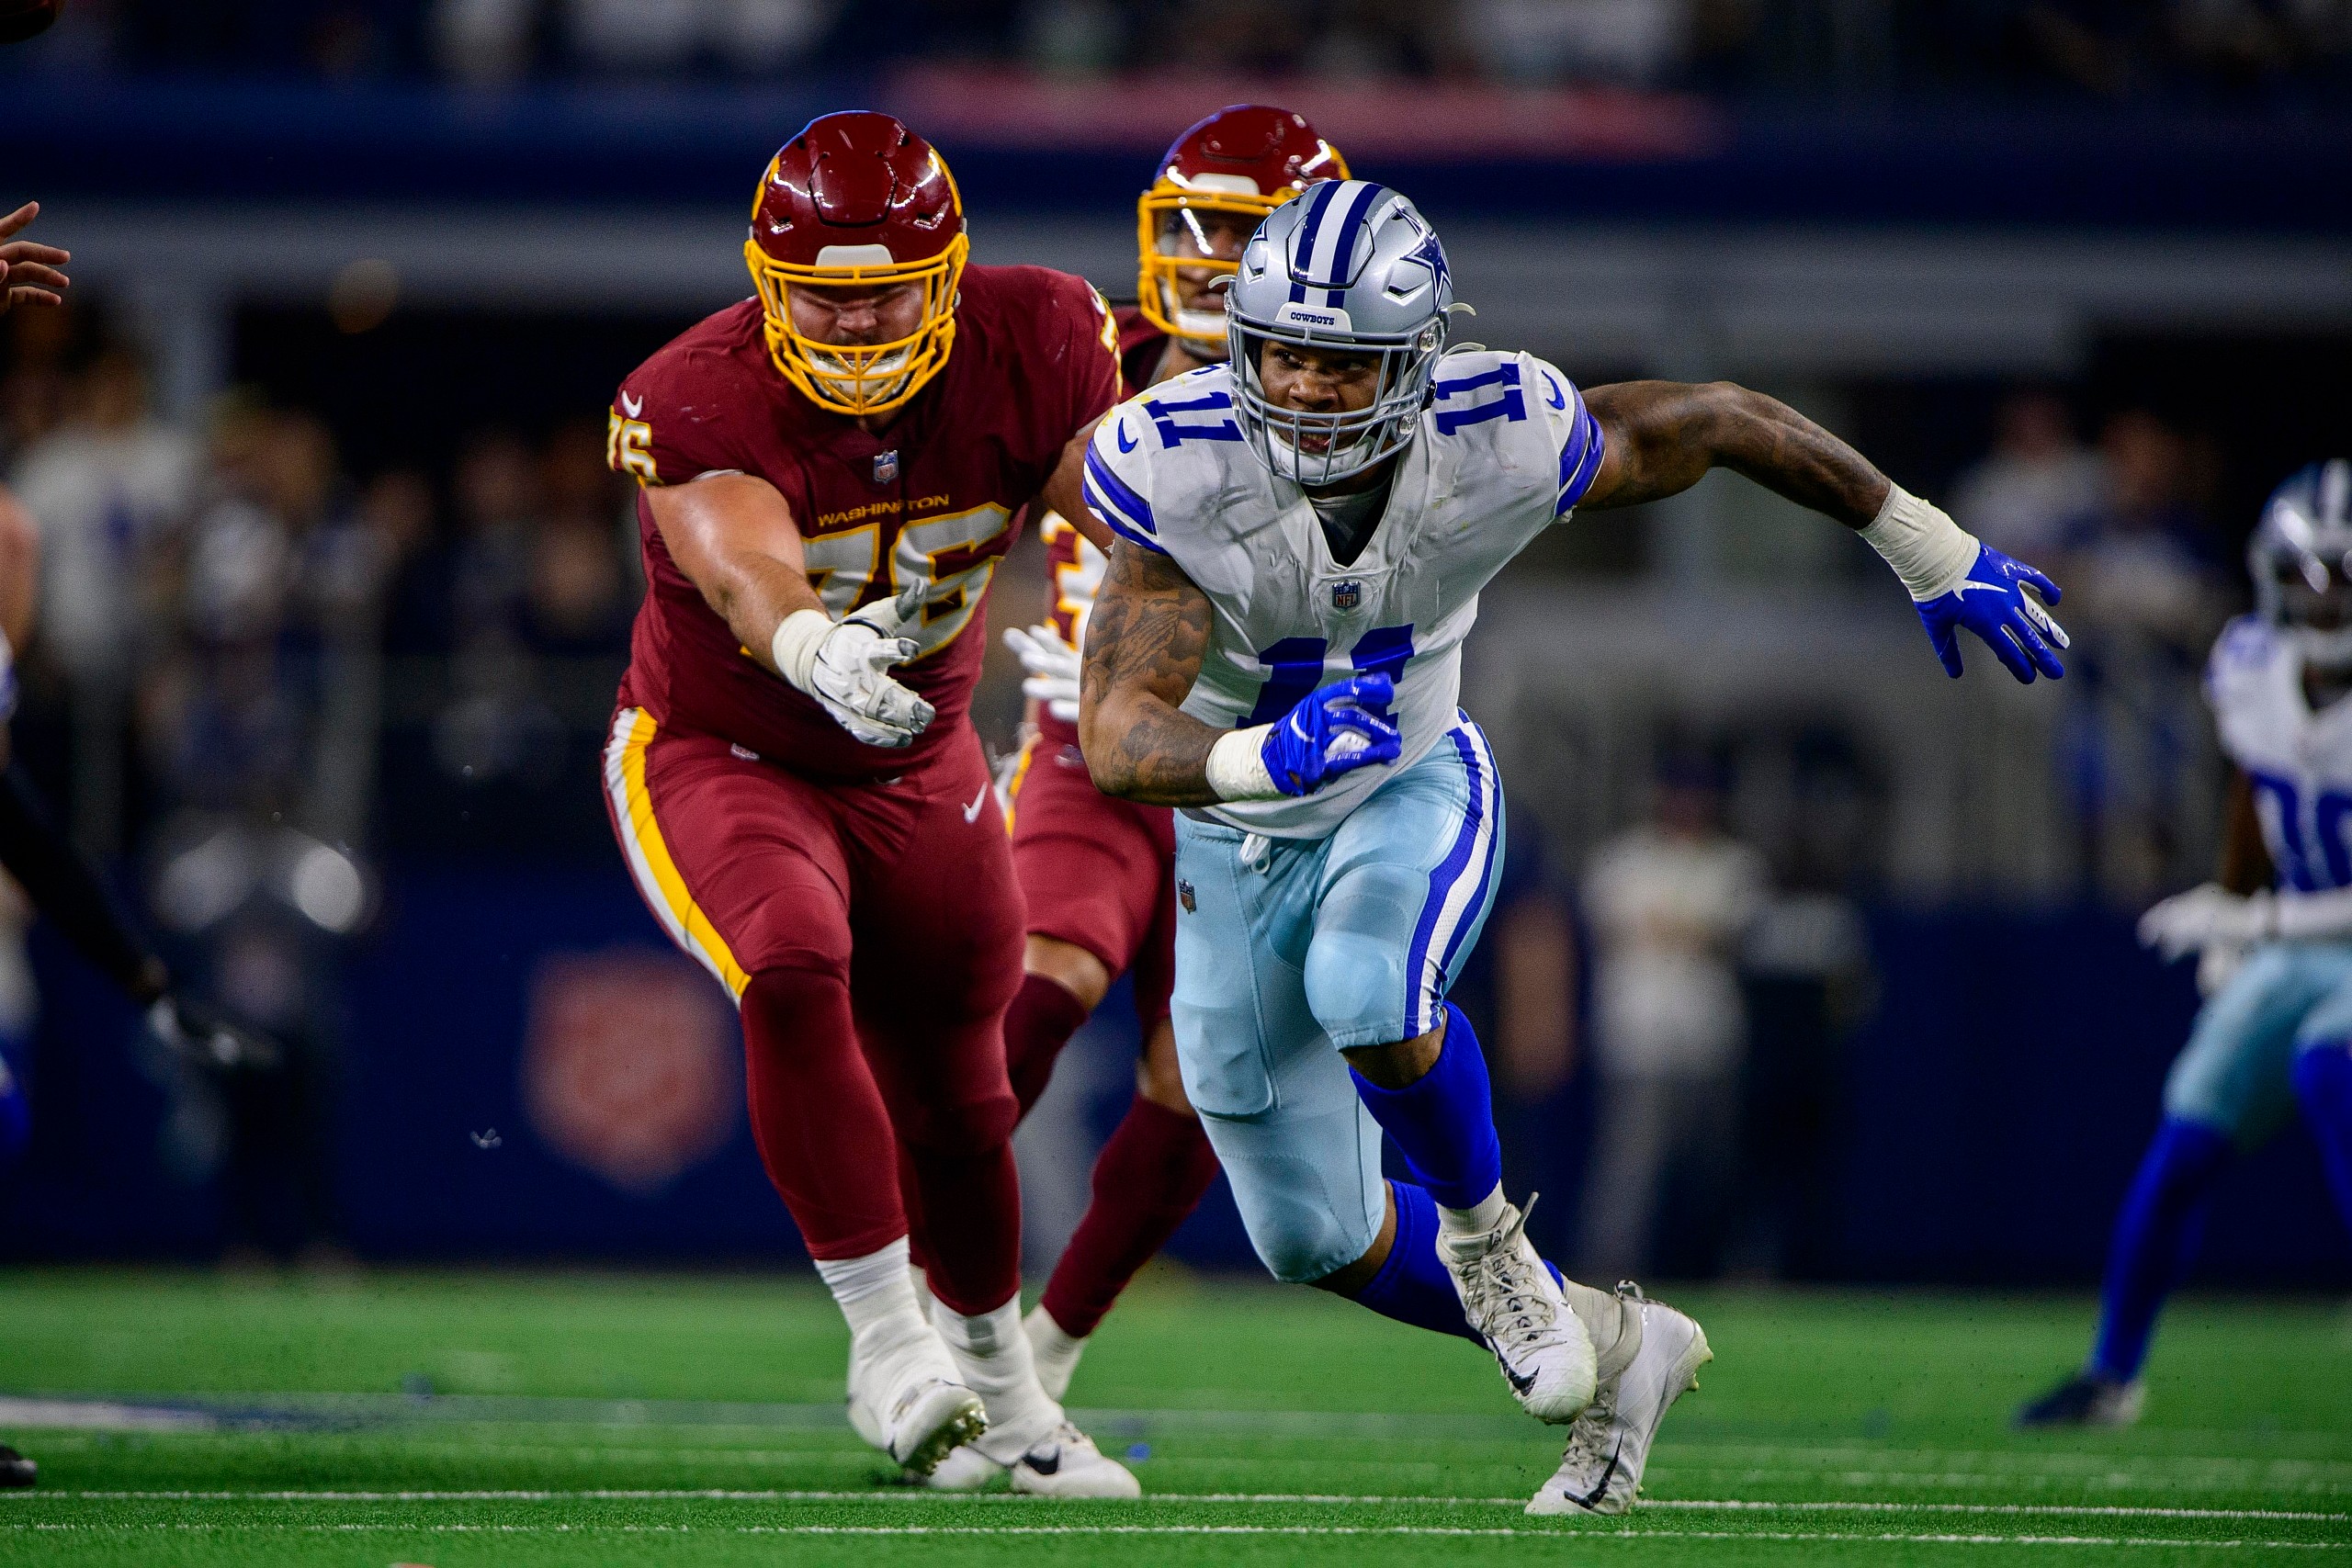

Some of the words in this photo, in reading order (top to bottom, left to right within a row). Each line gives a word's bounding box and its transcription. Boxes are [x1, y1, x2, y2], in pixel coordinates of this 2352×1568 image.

[1290, 311, 1335, 326] COWBOYS
[1141, 390, 1245, 450] 11
[1435, 363, 1527, 436] 11
[797, 501, 1012, 668] 76
[1236, 623, 1415, 733] 11
